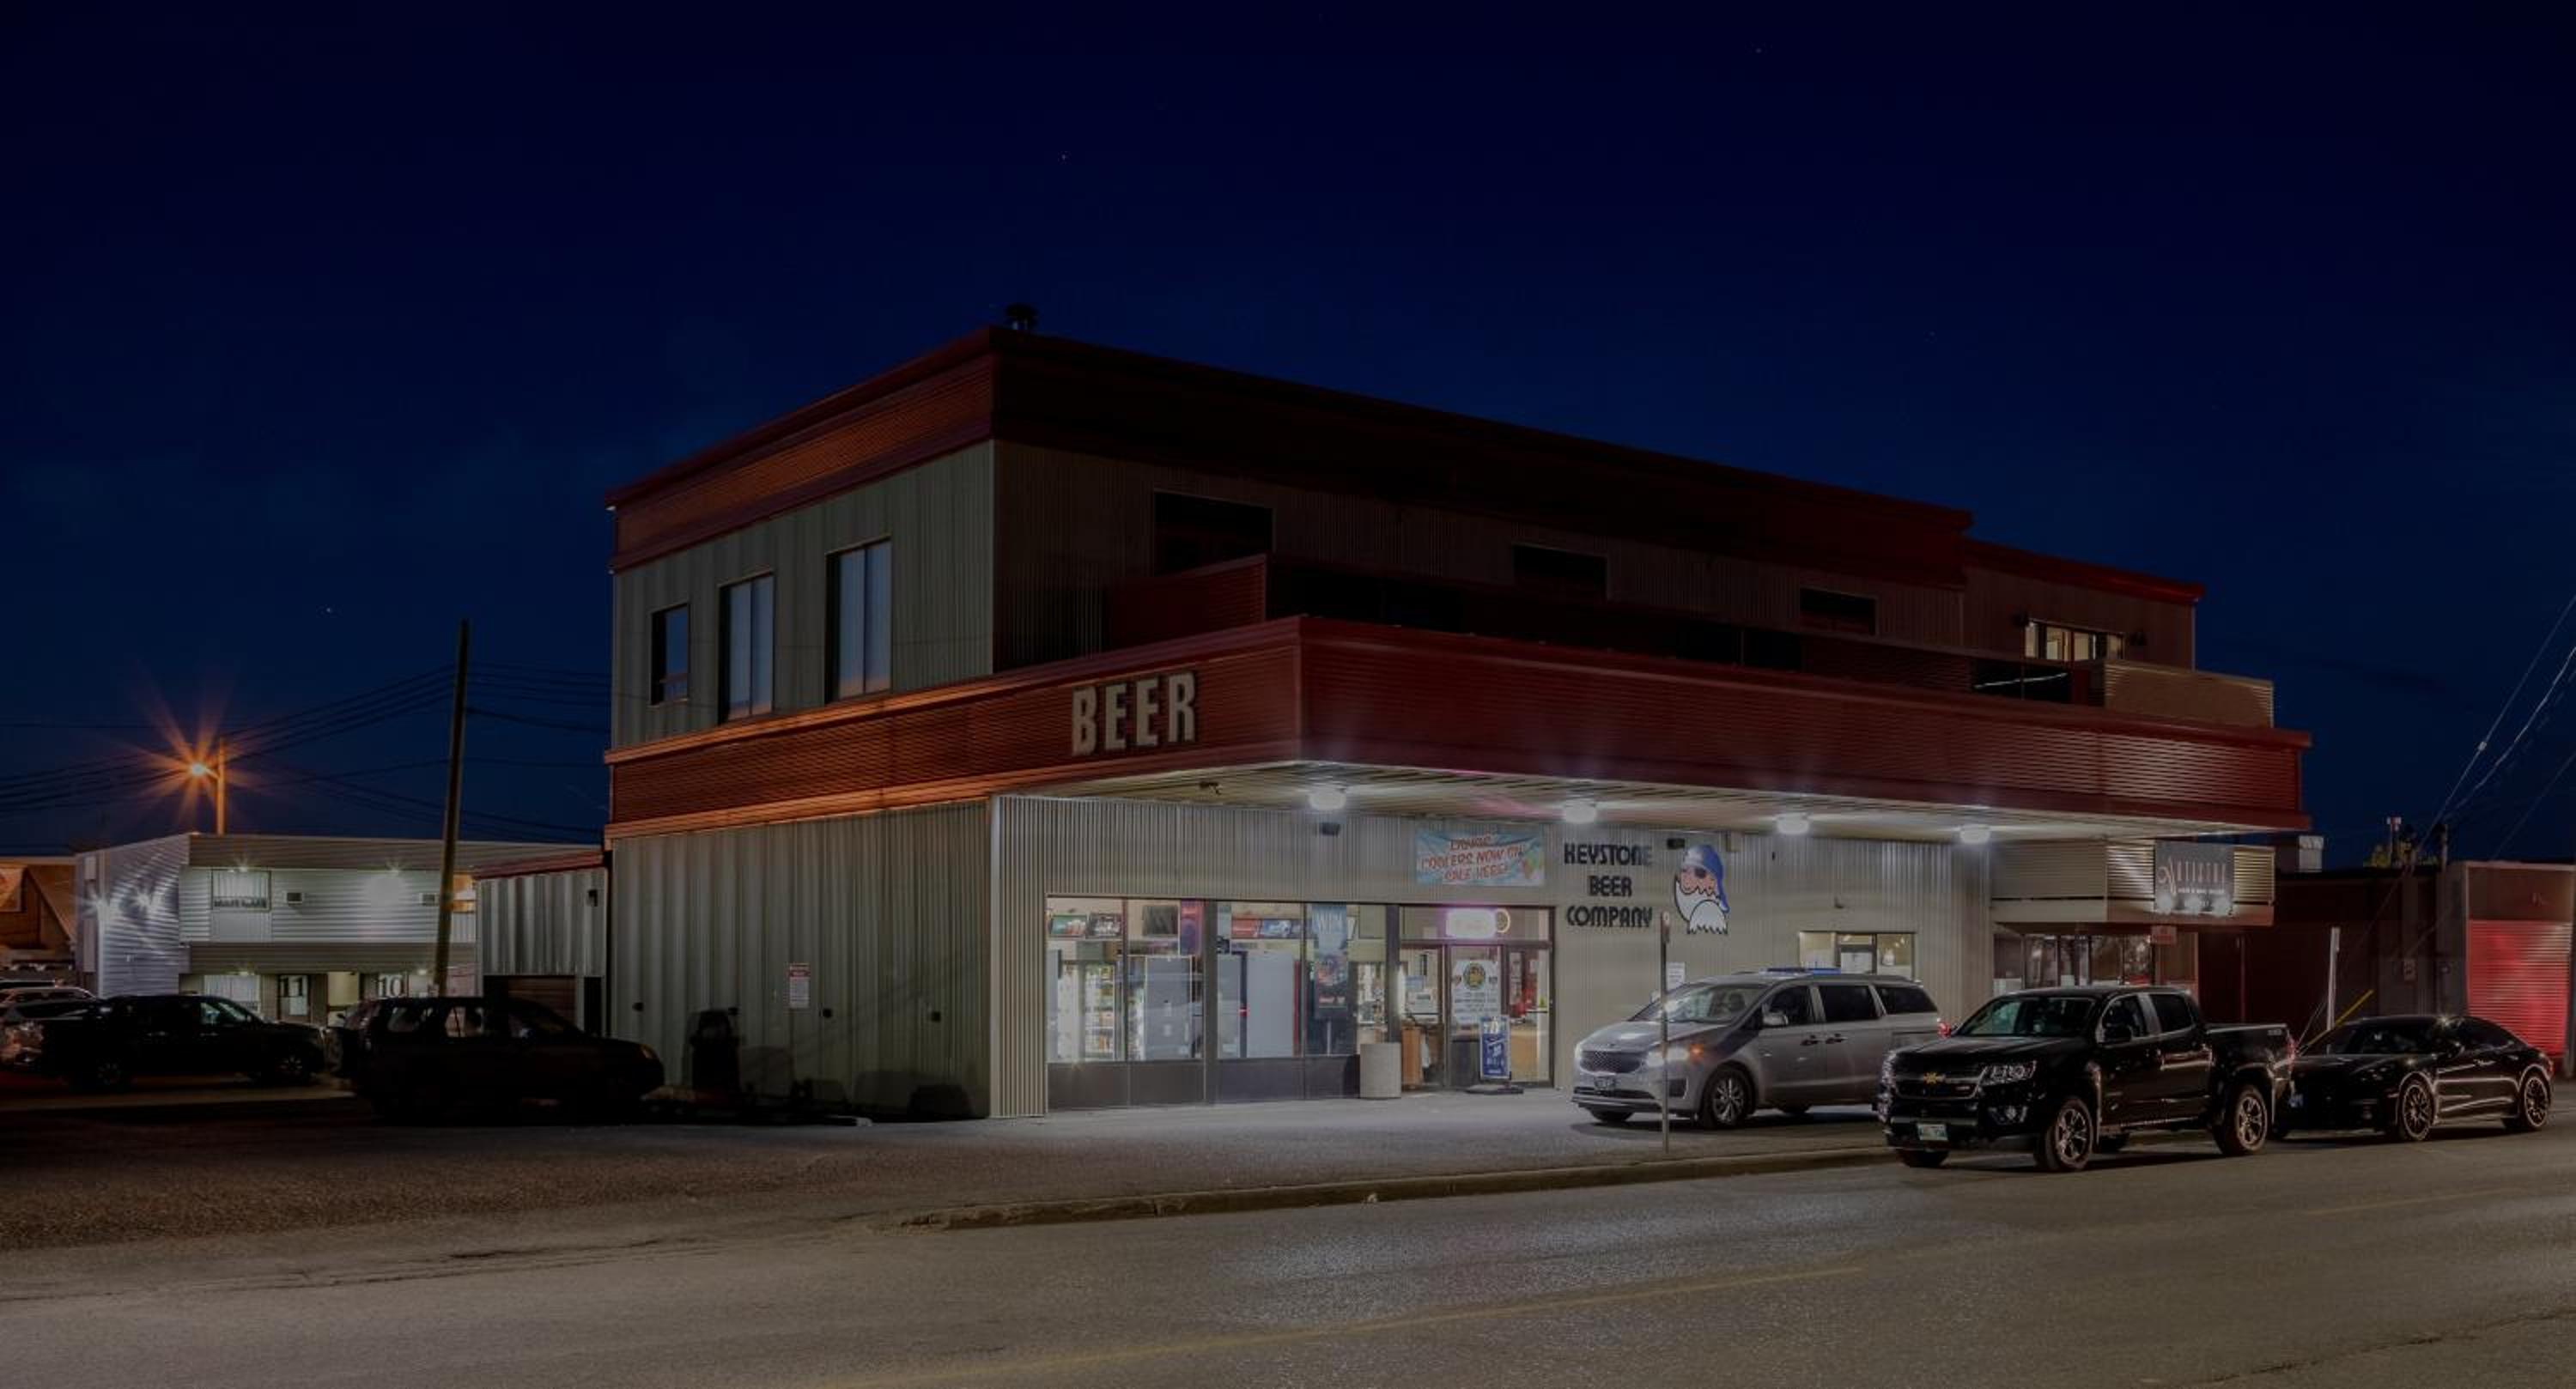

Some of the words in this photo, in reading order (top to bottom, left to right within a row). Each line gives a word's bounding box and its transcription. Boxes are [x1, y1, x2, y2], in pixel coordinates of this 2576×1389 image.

[1072, 670, 1197, 755] BEER
[1564, 842, 1652, 866] KEYSTONE
[1589, 876, 1632, 897] BEER
[1566, 905, 1653, 928] COMPANY
